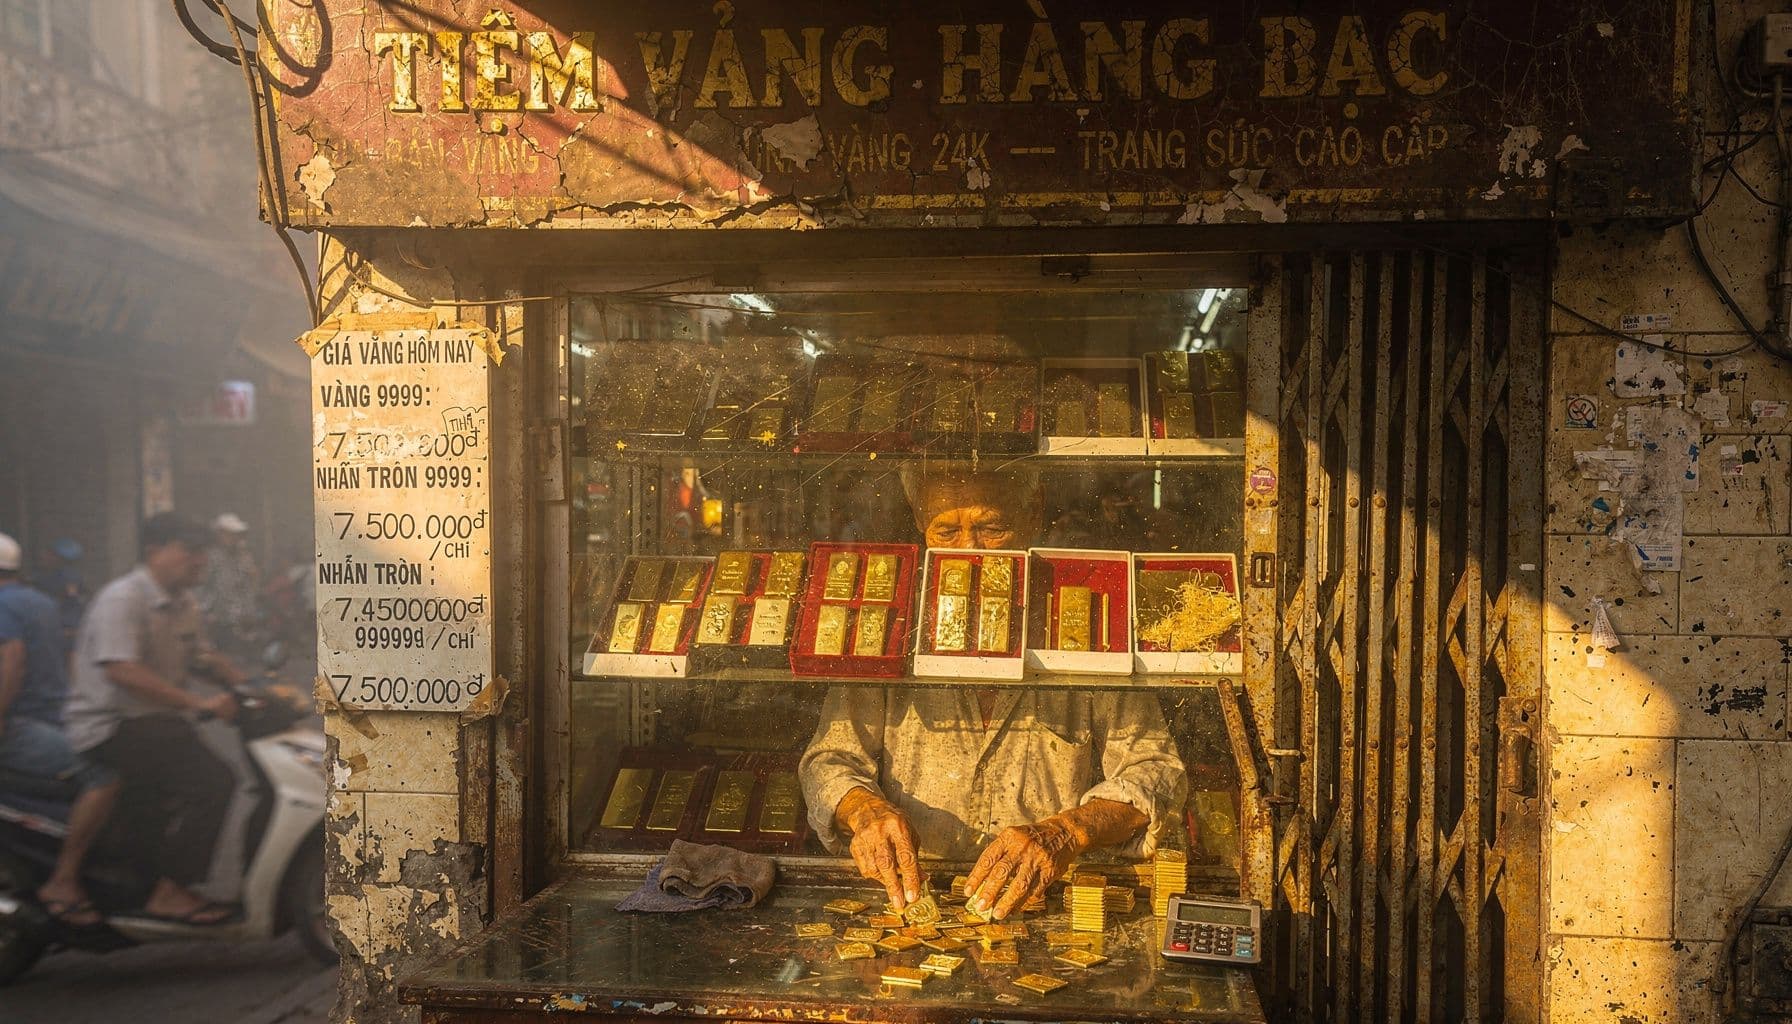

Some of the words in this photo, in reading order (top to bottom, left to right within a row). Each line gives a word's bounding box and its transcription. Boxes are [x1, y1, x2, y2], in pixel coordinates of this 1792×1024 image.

[374, 9, 602, 133] TIỆM
[936, 0, 1217, 104] HÀNG
[1258, 9, 1449, 120] BẠC
[932, 129, 992, 173] 24K
[1078, 129, 1186, 169] TRANG
[323, 336, 353, 365] GIÁ
[408, 336, 440, 364] HÔM
[444, 340, 475, 363] NAY
[321, 379, 371, 407] VÀNG
[377, 384, 431, 407] 9999:
